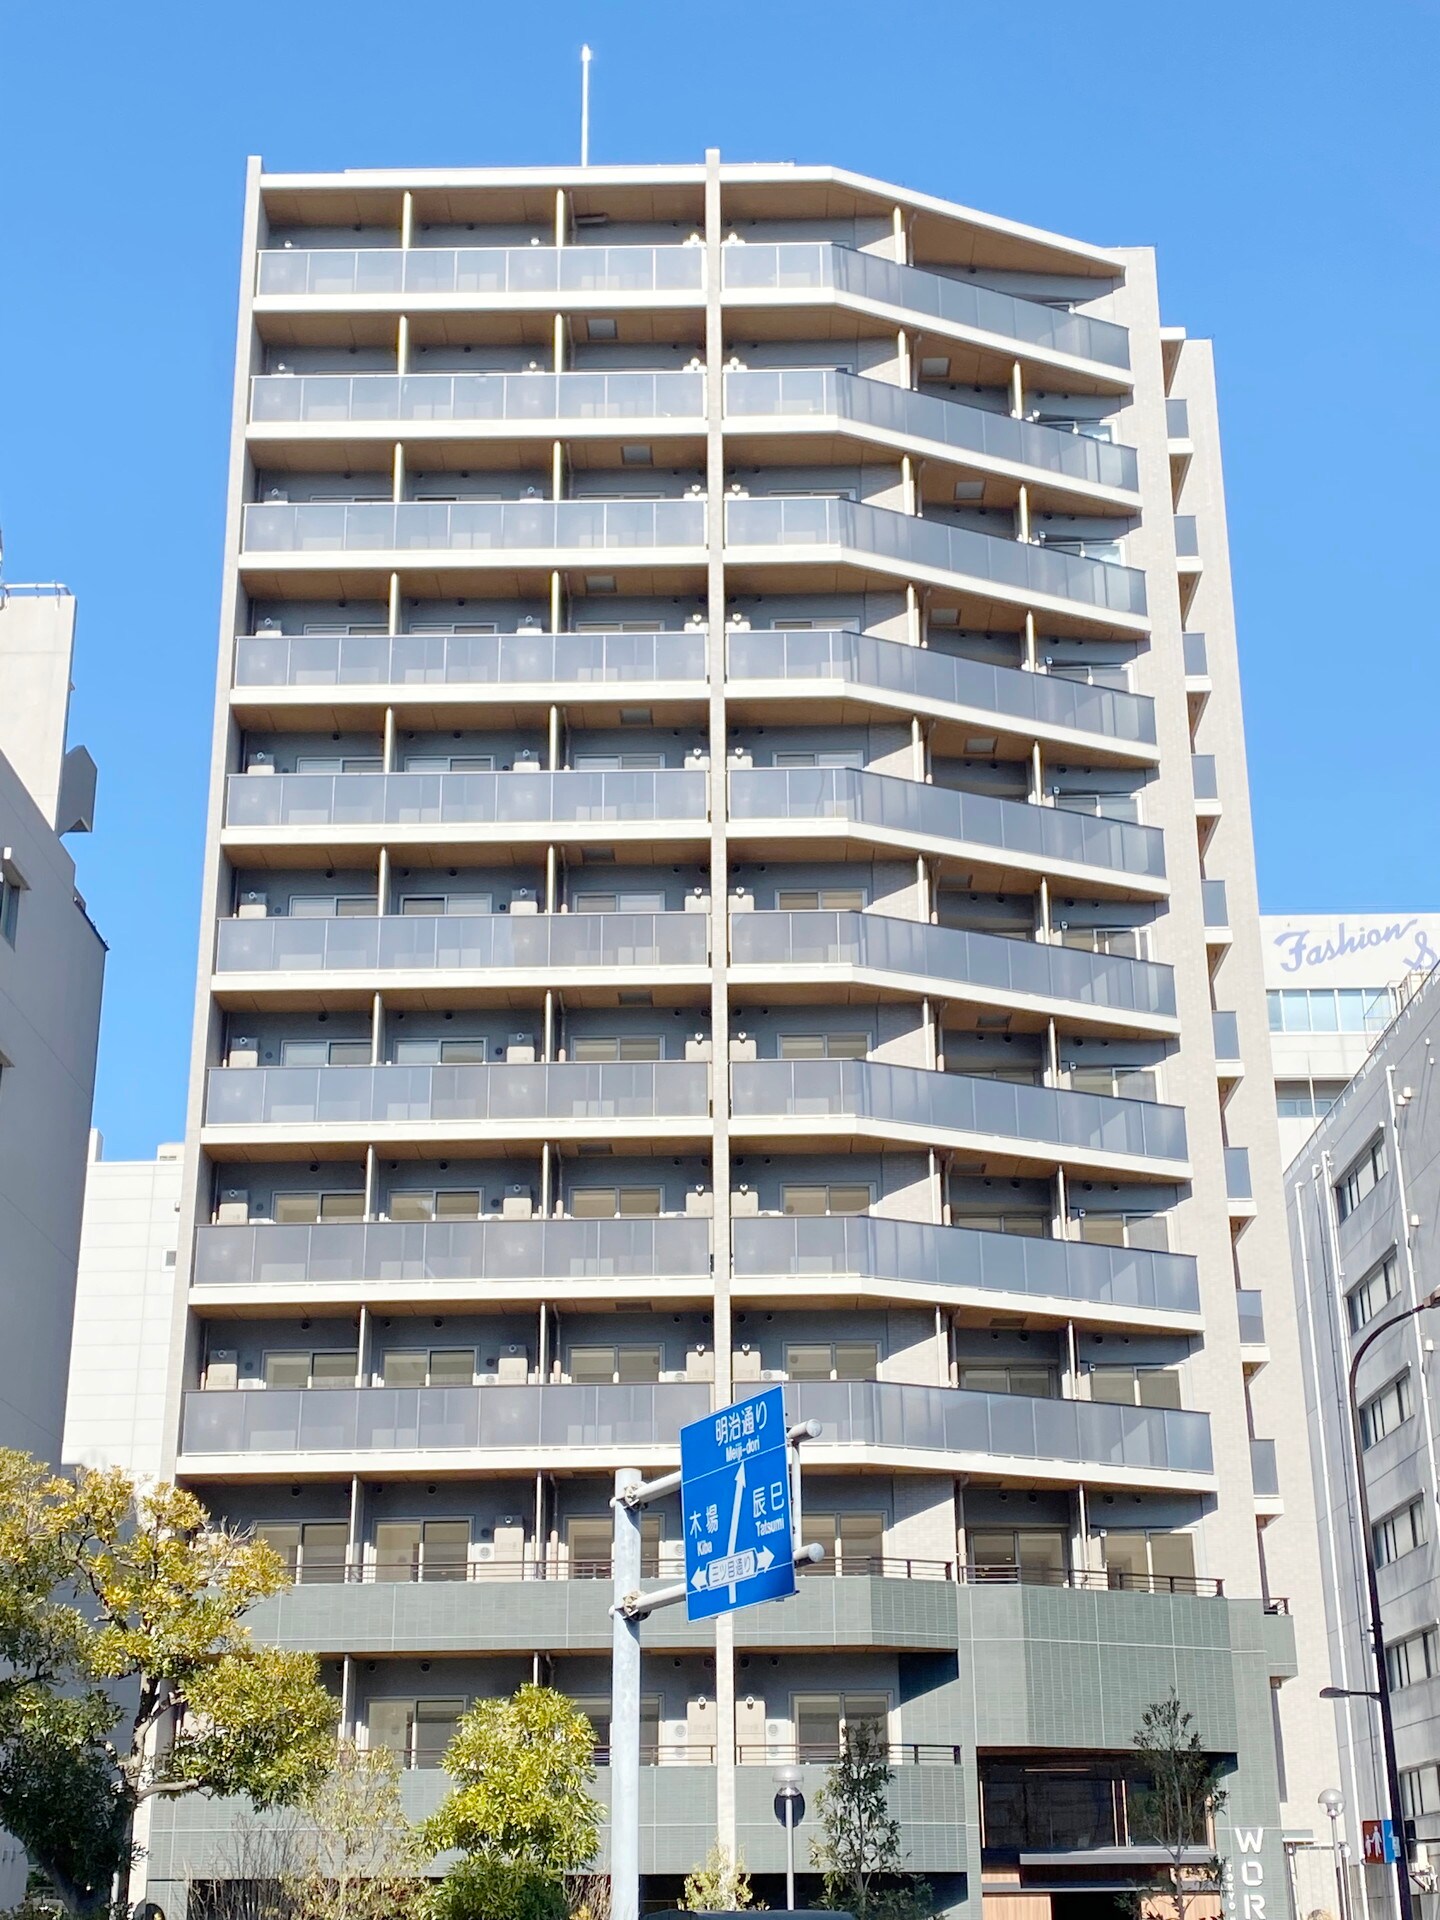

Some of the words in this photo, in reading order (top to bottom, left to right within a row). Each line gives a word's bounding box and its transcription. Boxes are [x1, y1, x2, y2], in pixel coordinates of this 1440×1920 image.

[1273, 918, 1418, 973] Fashion
[715, 1400, 768, 1447] 明治通り
[725, 1439, 760, 1463] Meiji-dori
[752, 1481, 785, 1519] 辰巳
[689, 1503, 719, 1539] 木場
[755, 1513, 785, 1537] Tatsumi
[696, 1539, 713, 1557] Kiba
[711, 1555, 752, 1583] 三ツ目通り
[1225, 1863, 1236, 1911] TOKYO
